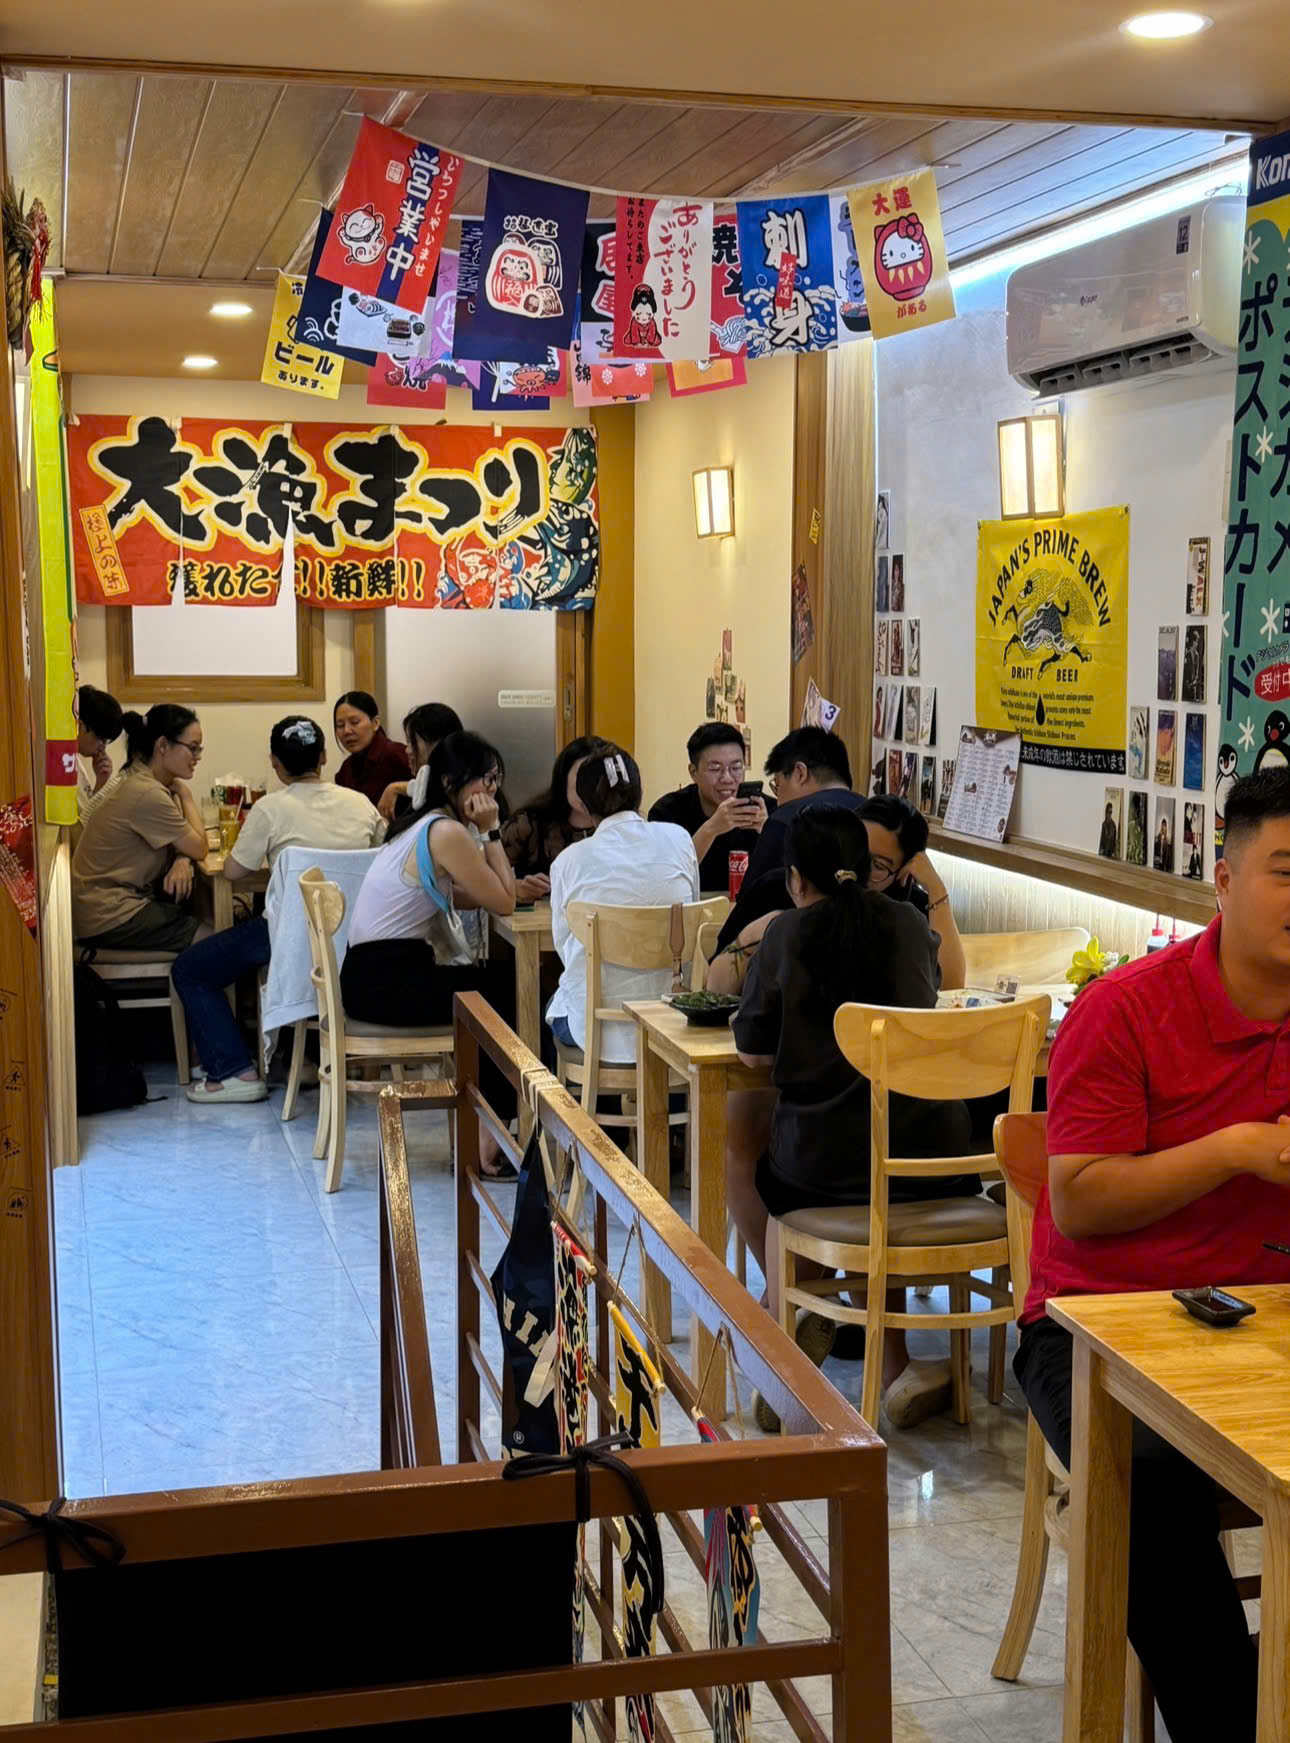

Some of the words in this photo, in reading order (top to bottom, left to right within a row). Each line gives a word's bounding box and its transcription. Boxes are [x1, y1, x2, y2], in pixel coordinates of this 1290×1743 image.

[386, 148, 441, 281] 営業中
[673, 201, 703, 311] ありがとう
[653, 220, 680, 338] ございました
[274, 341, 335, 376] ビール
[96, 416, 542, 548] 大漁まつり
[1225, 273, 1278, 721] ポストカード
[989, 538, 1031, 627] JAPAN'S
[1034, 528, 1079, 564] PRIME
[1079, 550, 1111, 628] BREW
[1011, 664, 1034, 681] DRAFT
[1056, 668, 1079, 683] BEER
